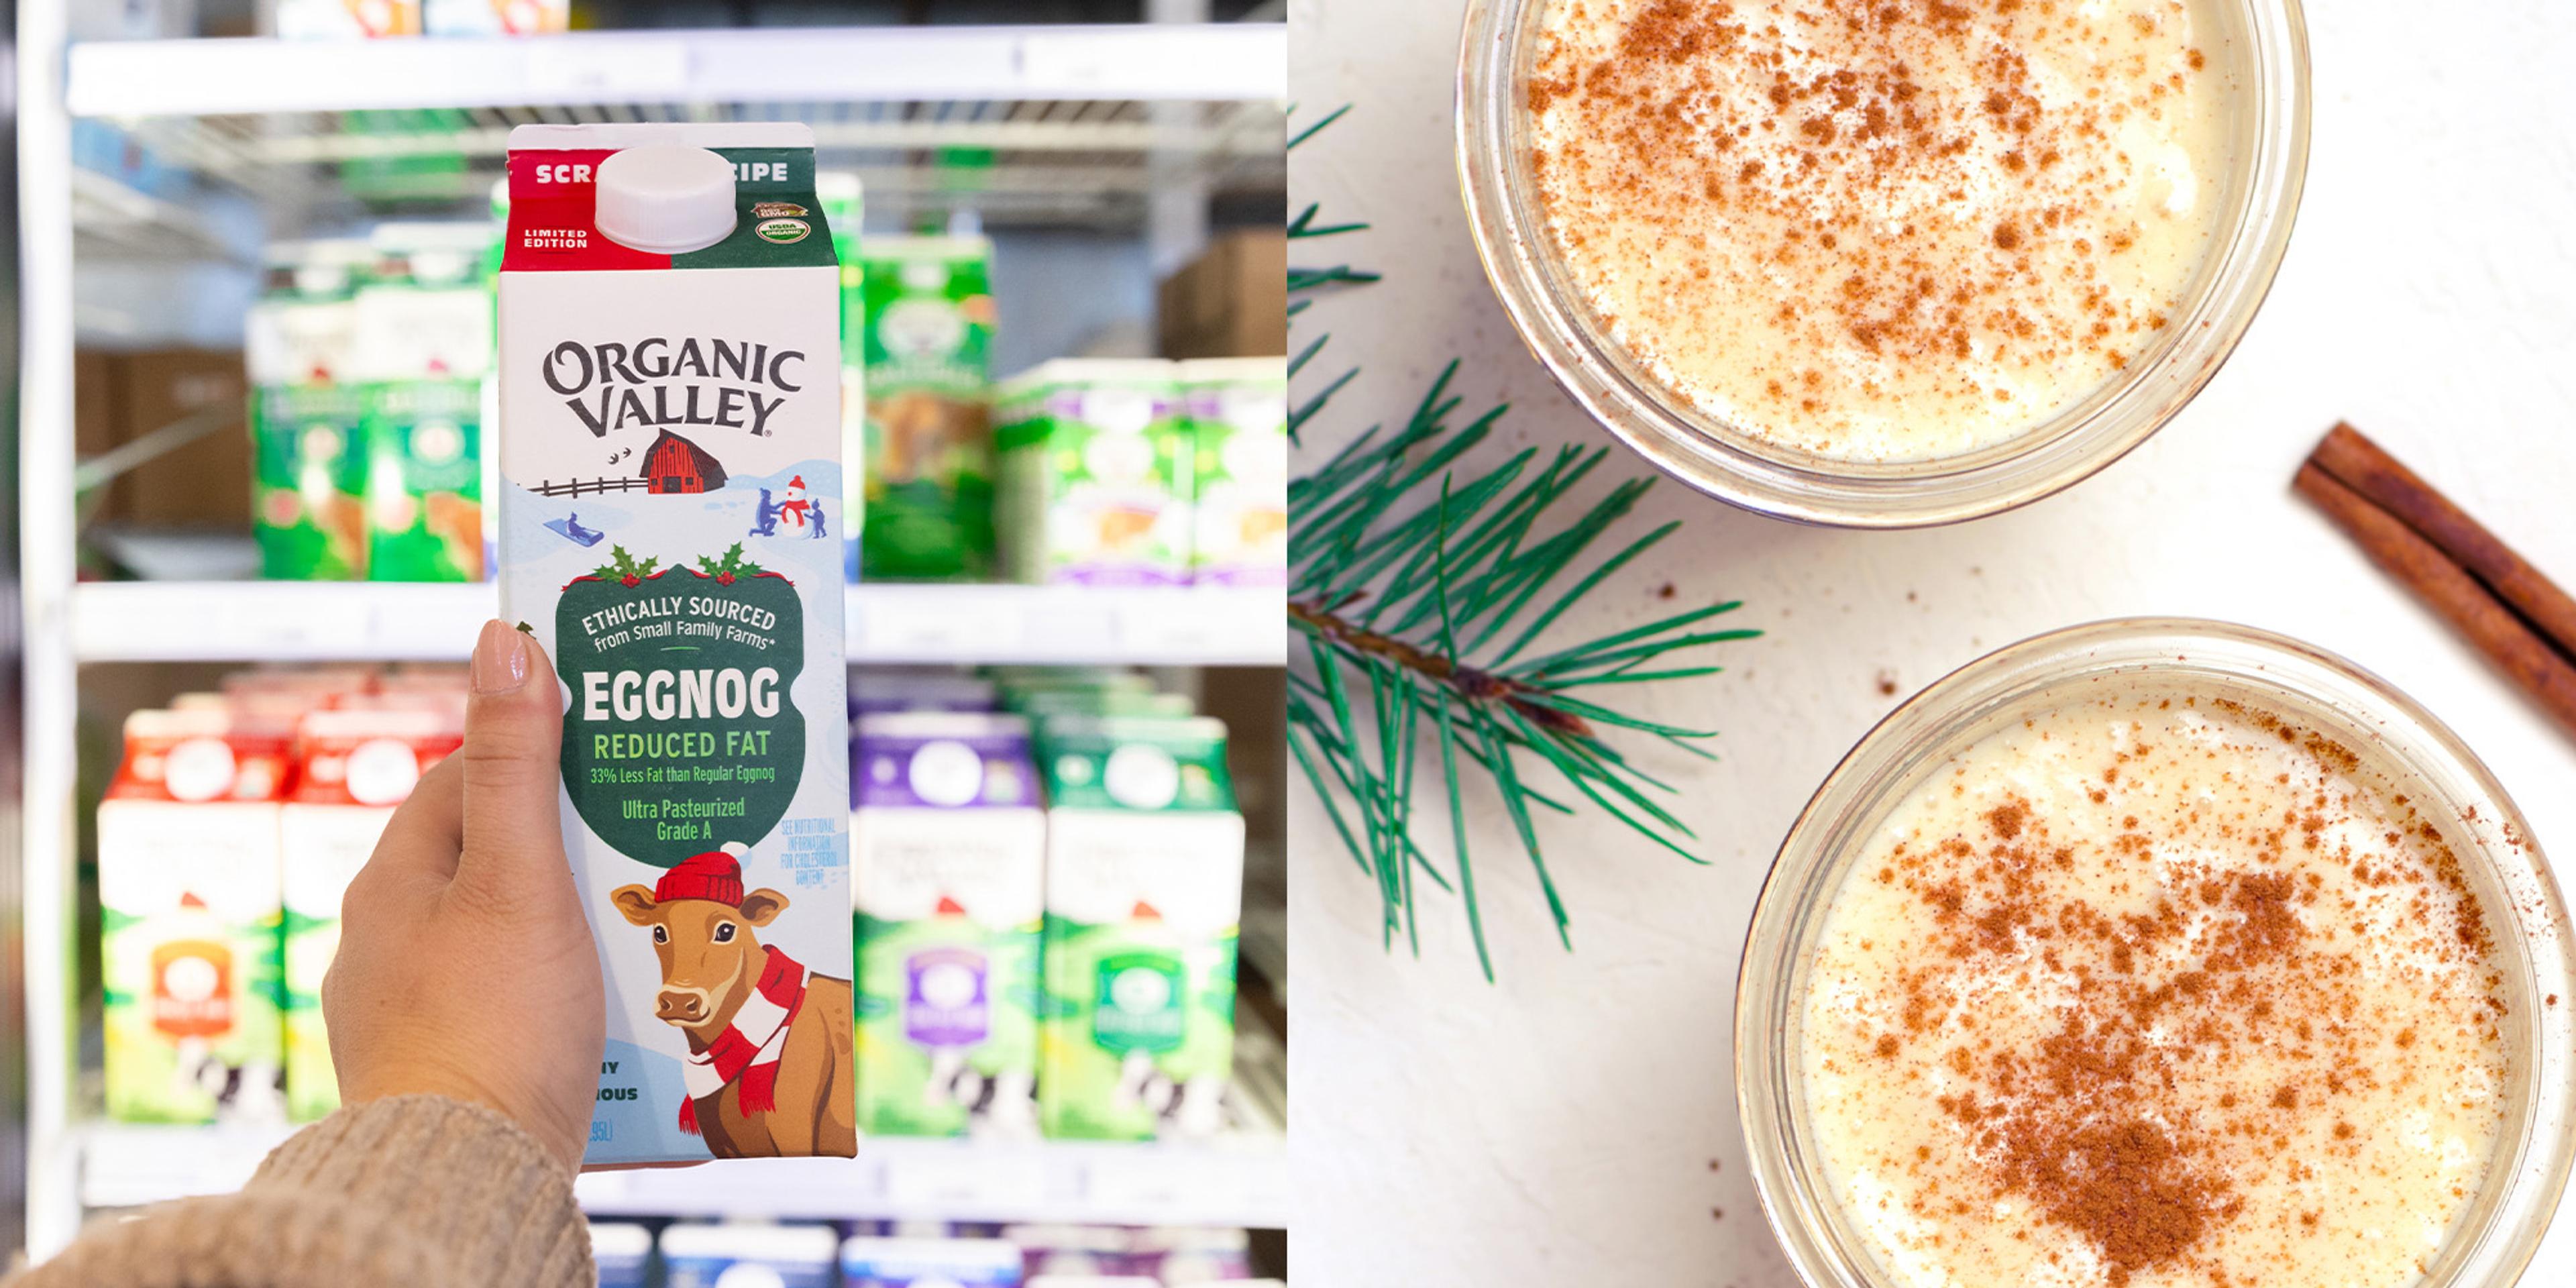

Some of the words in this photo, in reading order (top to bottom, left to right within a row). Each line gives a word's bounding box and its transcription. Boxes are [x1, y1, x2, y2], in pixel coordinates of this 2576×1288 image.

[536, 164, 596, 183] SCR
[524, 229, 587, 238] LIMITED
[524, 238, 587, 248] EDITION
[543, 337, 804, 395] ORGANIC
[582, 596, 682, 636] ETHICALLY
[689, 596, 775, 631] SOURCED
[594, 630, 631, 653] from
[633, 621, 671, 640] Small
[677, 621, 722, 640] Family
[582, 667, 780, 721] EGGNOG
[594, 732, 716, 759] REDUCED
[727, 731, 771, 757] FAT
[591, 768, 616, 784] 33%
[620, 768, 644, 783] Less
[647, 767, 663, 783] Fat
[666, 767, 690, 782] than
[694, 765, 733, 785] Regular
[737, 765, 775, 784] Eggnog
[623, 800, 658, 819] Ultra
[662, 797, 745, 818] Pasteurized
[657, 821, 698, 841] Grade
[704, 820, 712, 839] A
[781, 819, 793, 835] SEE
